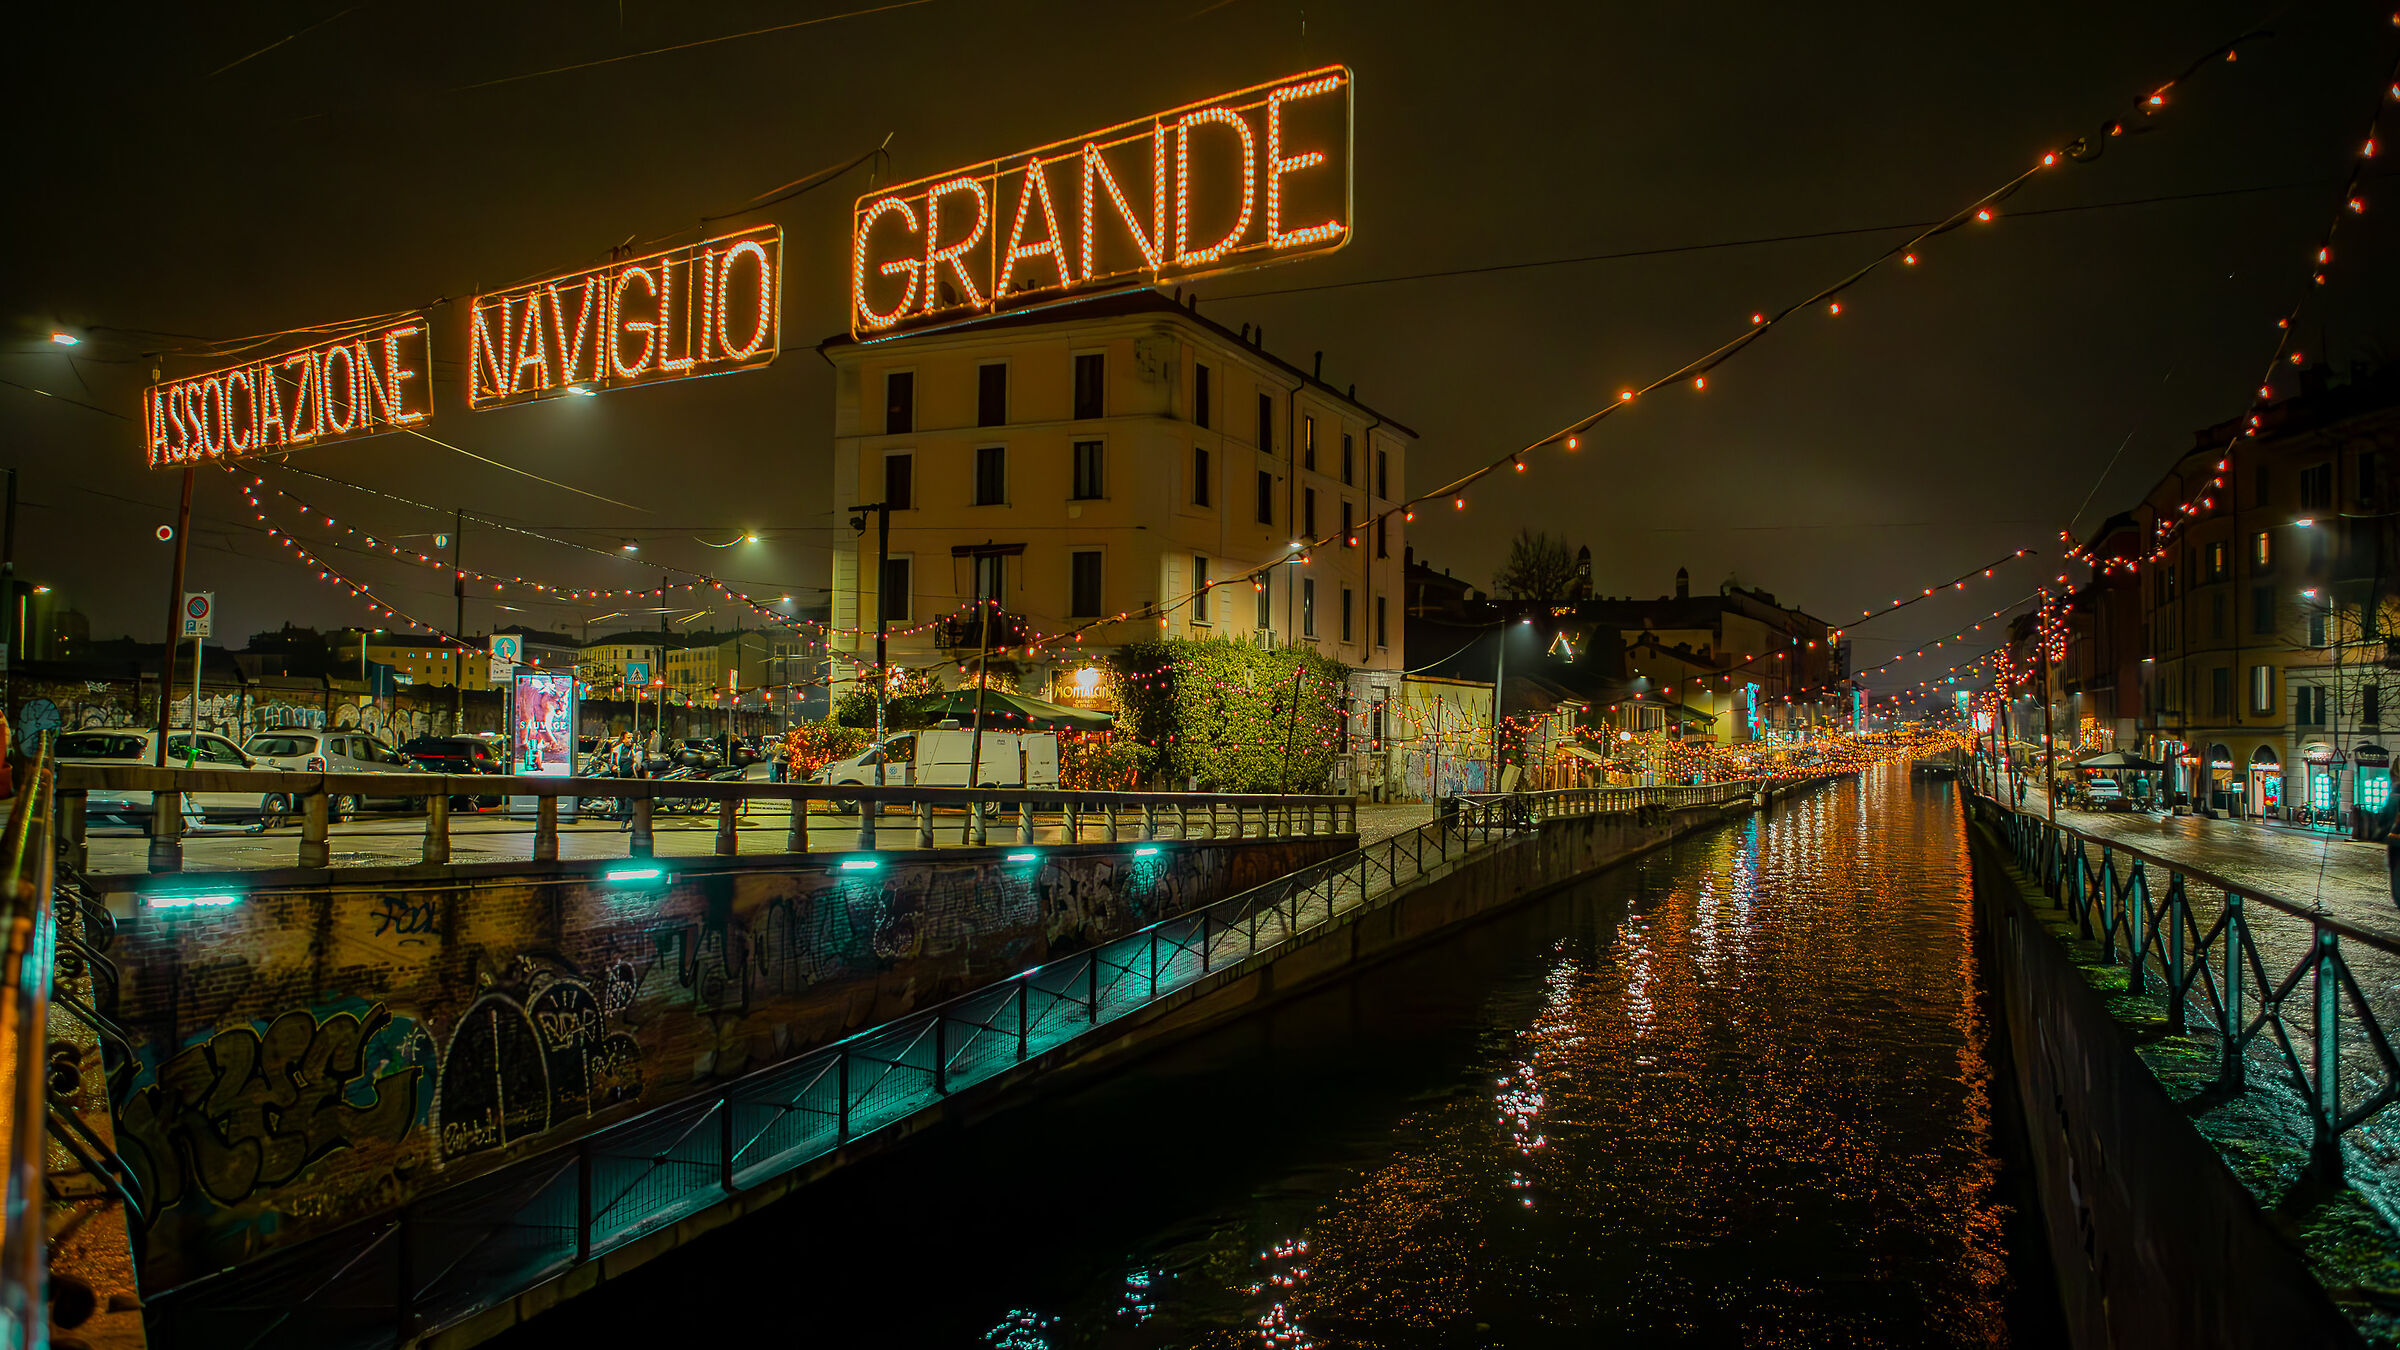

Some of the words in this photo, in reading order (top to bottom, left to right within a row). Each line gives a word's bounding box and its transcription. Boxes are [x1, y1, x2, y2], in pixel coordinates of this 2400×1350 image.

[150, 326, 425, 466] ASSOCIAZIONE
[470, 239, 771, 401] NAVIGLIO
[855, 75, 1340, 328] GRANDE
[1054, 686, 1112, 698] MONTALCIN
